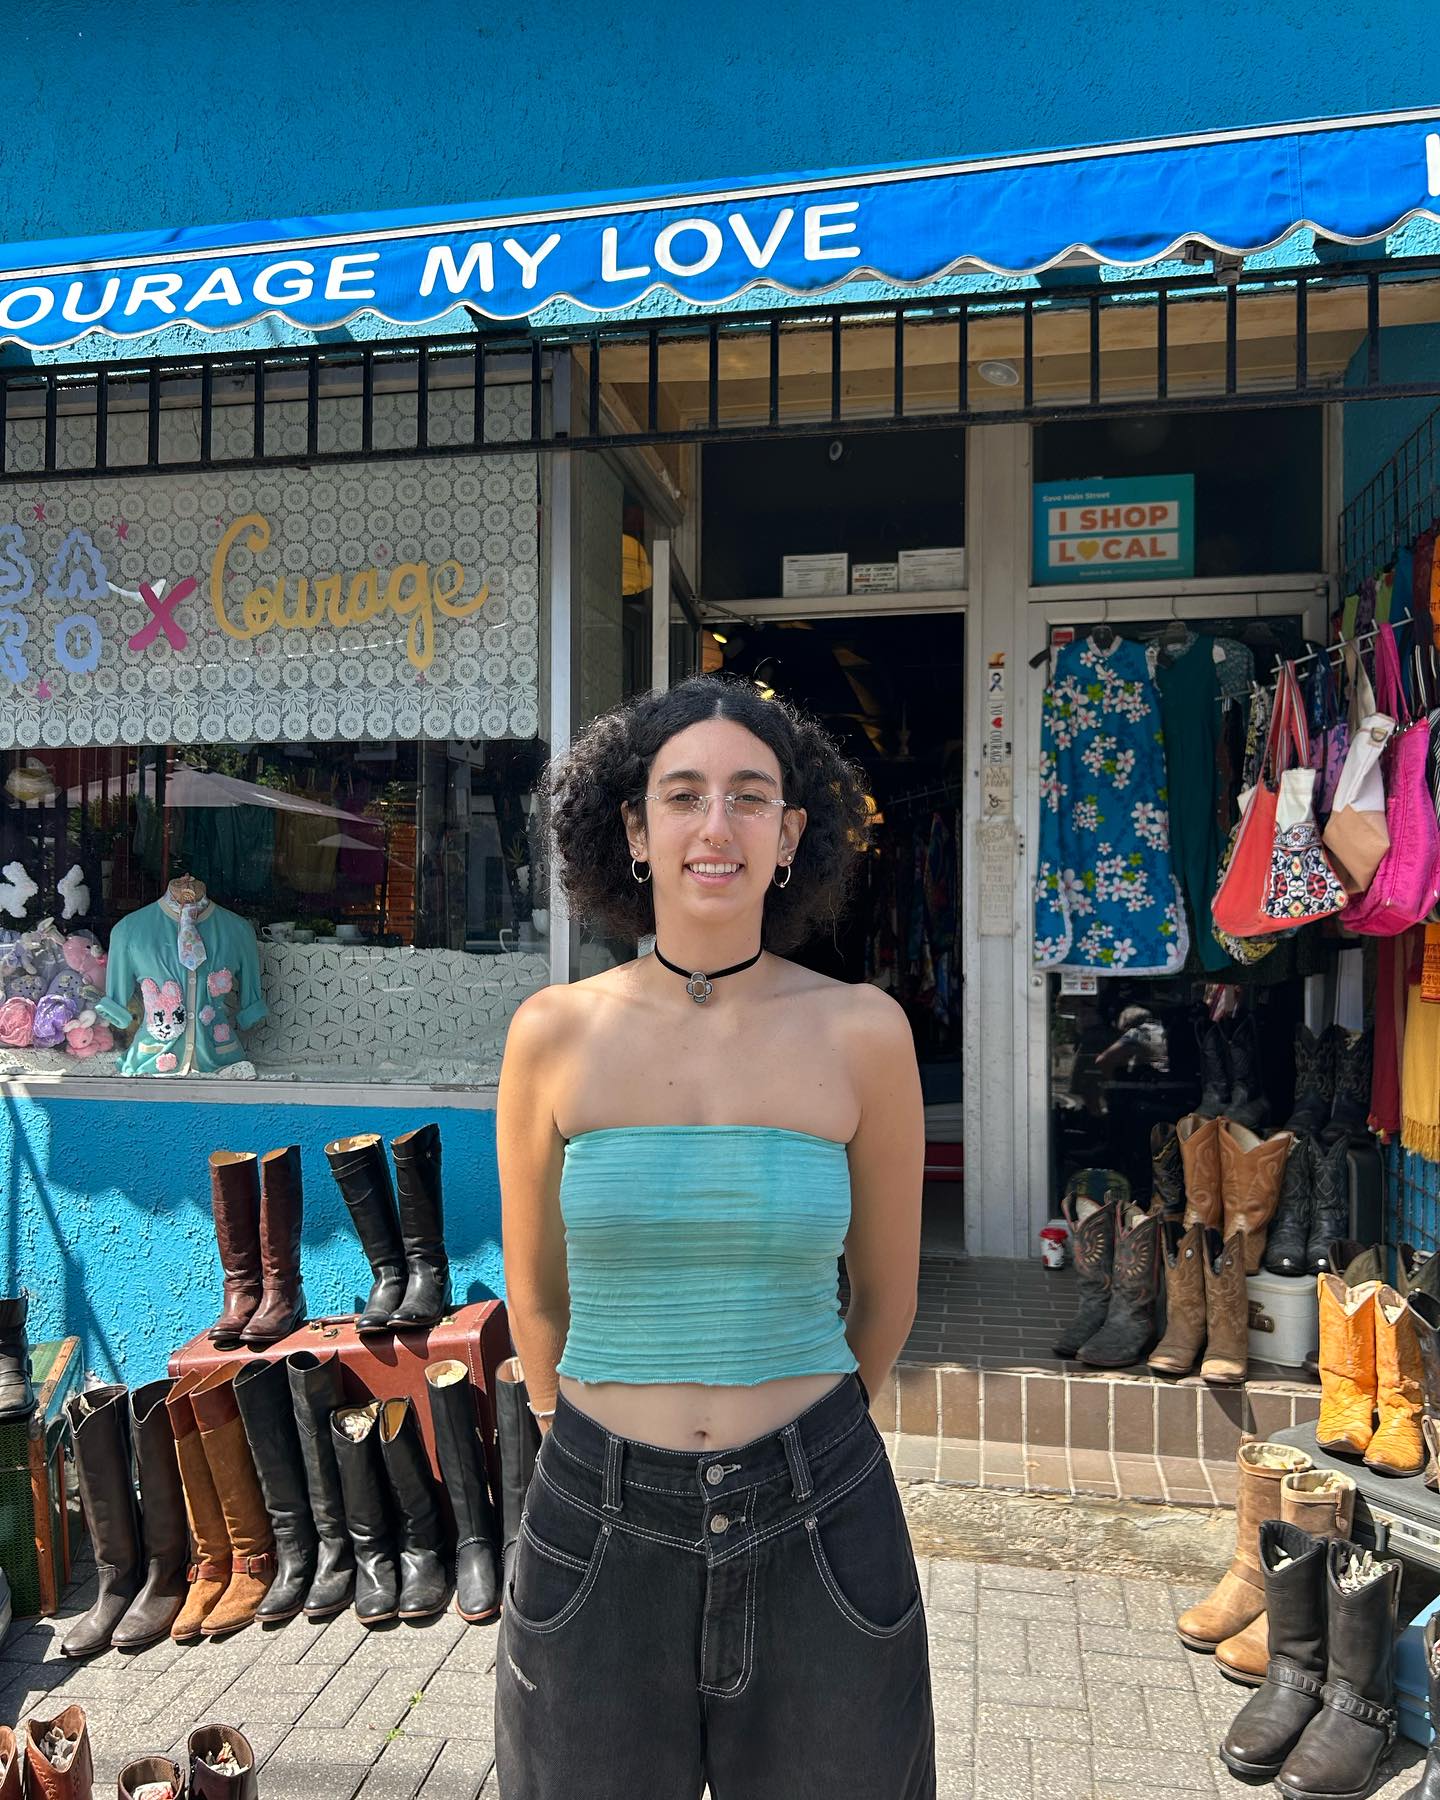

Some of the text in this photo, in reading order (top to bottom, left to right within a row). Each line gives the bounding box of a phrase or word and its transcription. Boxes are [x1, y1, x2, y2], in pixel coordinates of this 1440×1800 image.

[0, 201, 862, 330] OURAGE MY LOVE
[1058, 505, 1169, 532] I SHOP
[1063, 492, 1084, 500] Main
[1085, 491, 1111, 500] Street
[209, 512, 490, 671] Courage
